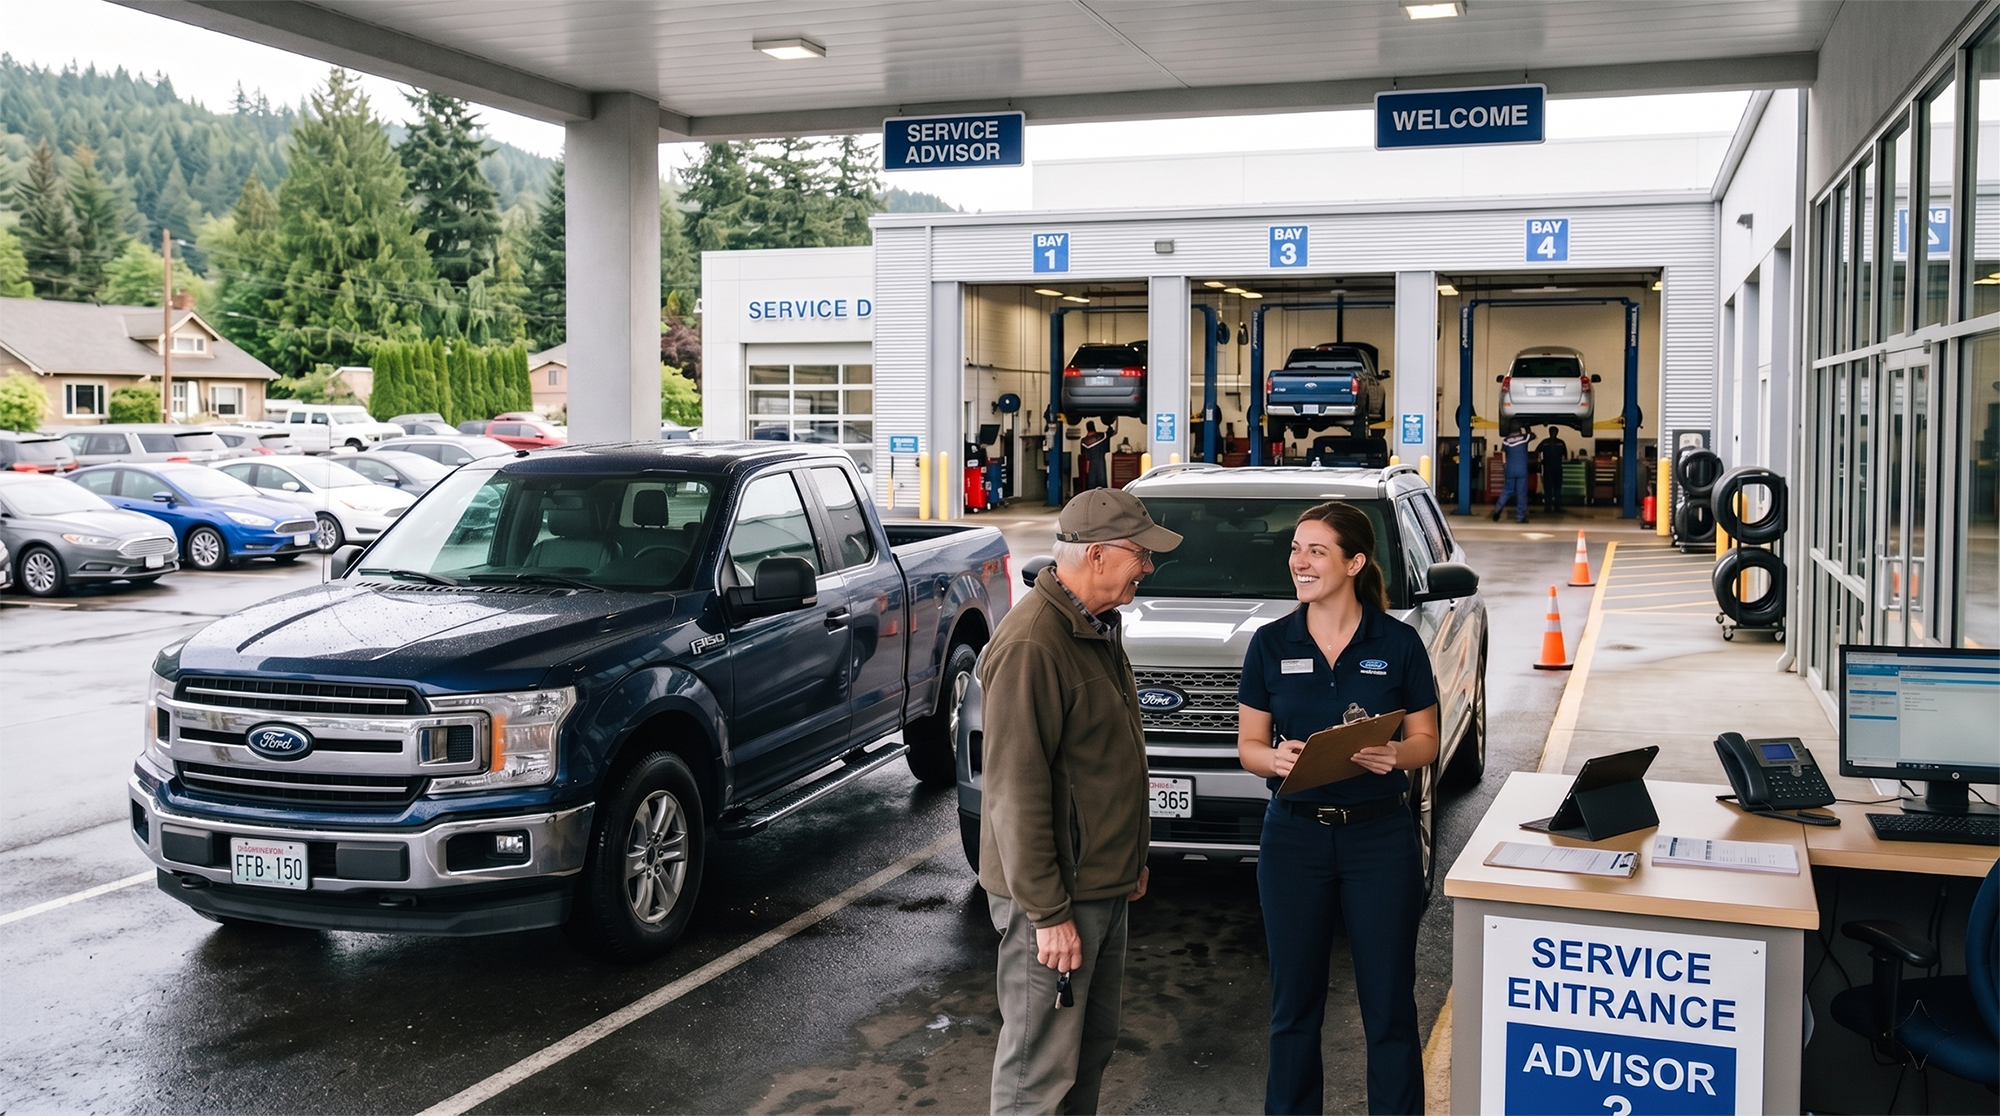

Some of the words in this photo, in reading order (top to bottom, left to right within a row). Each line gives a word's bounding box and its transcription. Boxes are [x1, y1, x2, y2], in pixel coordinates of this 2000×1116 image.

[1392, 104, 1528, 131] WELCOME
[907, 120, 999, 143] SERVICE
[905, 142, 1001, 164] ADVISOR
[1274, 227, 1303, 241] BAY
[1531, 220, 1563, 234] BAY
[1037, 234, 1065, 247] BAY
[1537, 235, 1557, 259] 4
[1044, 248, 1055, 270] 1
[1280, 242, 1297, 265] 3
[748, 299, 848, 320] SERVICE
[1141, 691, 1172, 706] Ford
[259, 731, 294, 750] Ford
[1531, 937, 1712, 985] SERVICE
[1508, 976, 1737, 1032] ENTRANCE
[1522, 1042, 1717, 1097] ADVISOR
